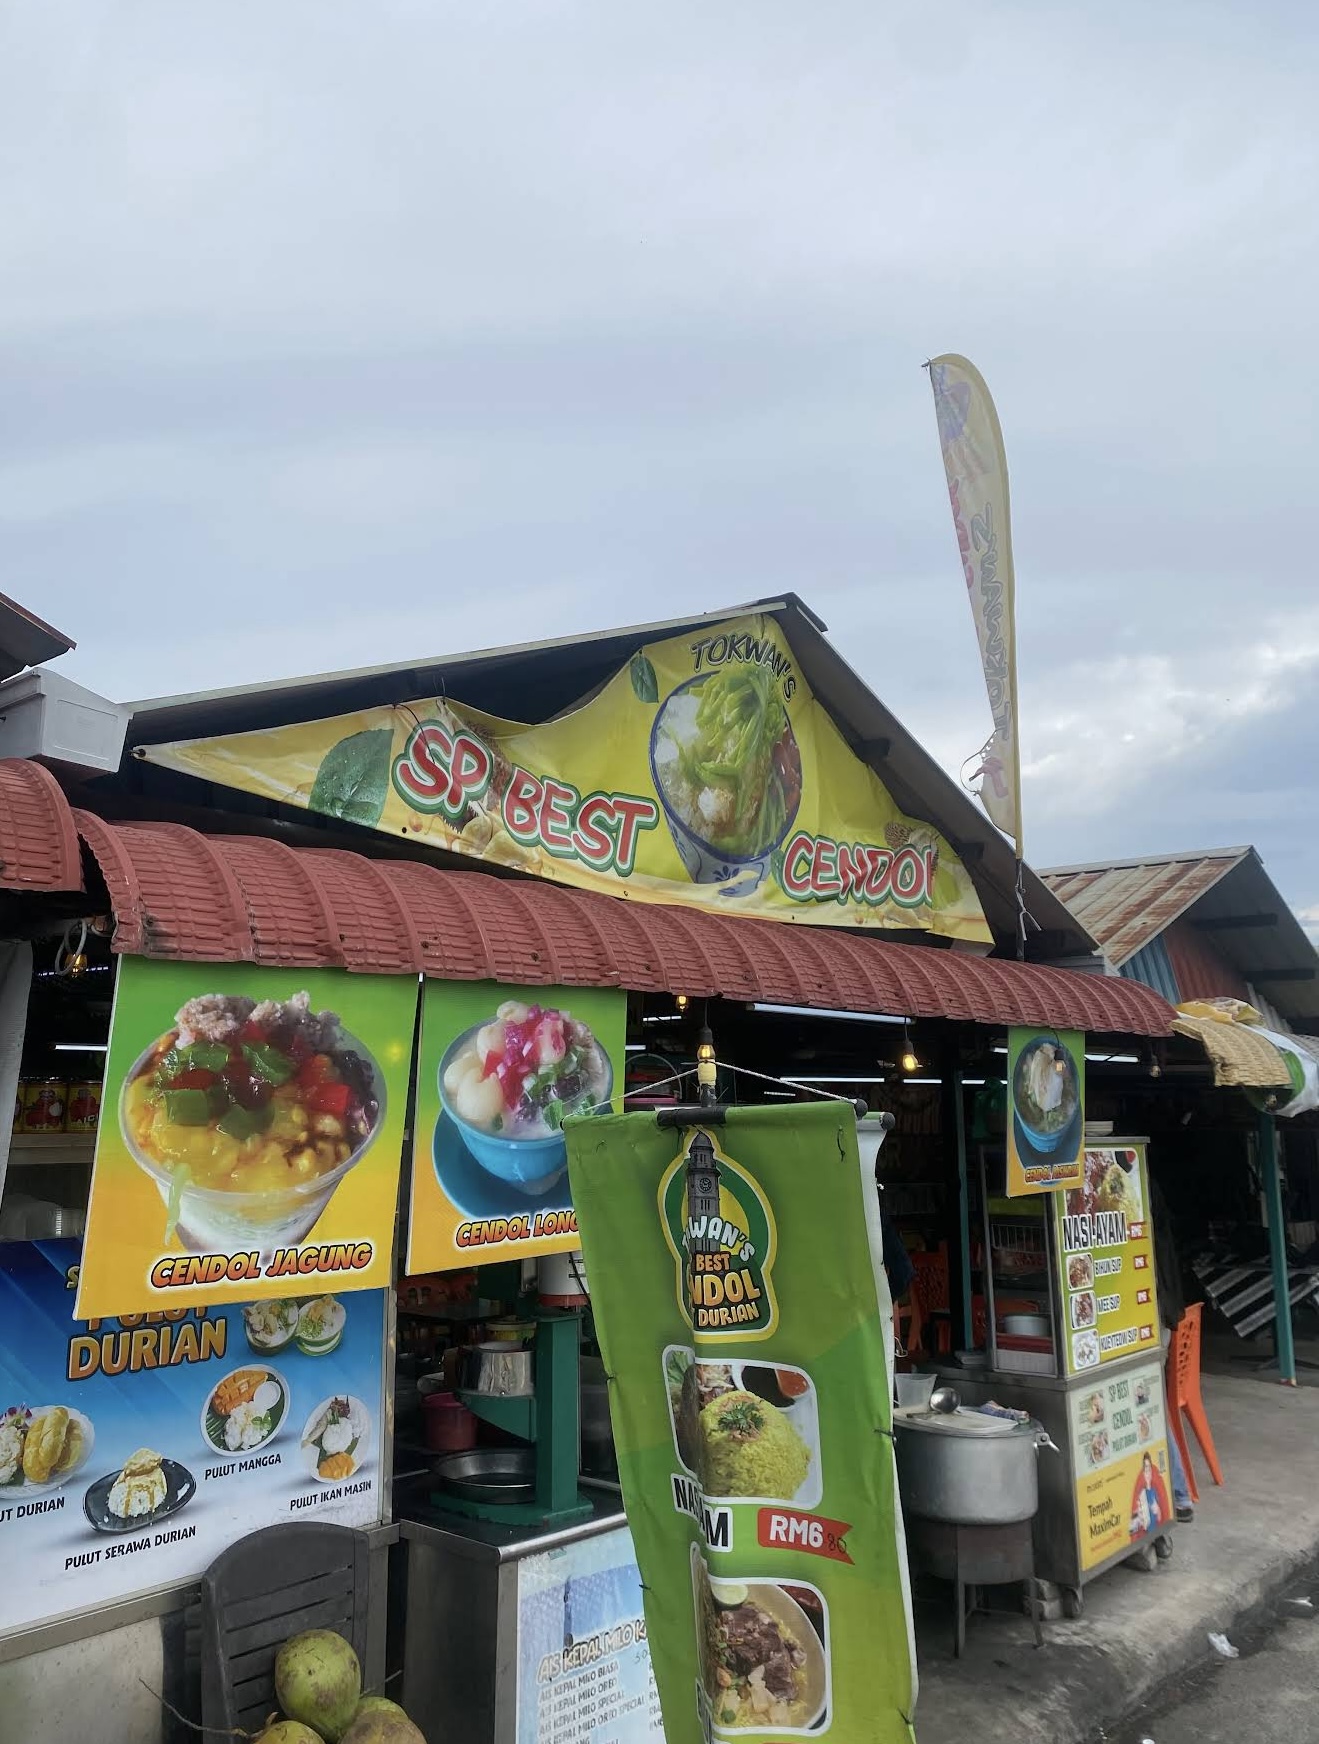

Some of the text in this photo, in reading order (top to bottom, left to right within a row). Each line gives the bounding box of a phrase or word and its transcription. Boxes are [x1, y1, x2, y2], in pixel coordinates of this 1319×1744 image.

[691, 634, 796, 702] TOKWAN'S
[395, 721, 657, 874] SP BEST
[456, 1216, 531, 1248] CENDOL
[1062, 1215, 1093, 1251] NASI
[1096, 1212, 1127, 1246] AYAM
[151, 1242, 373, 1289] CENDOL JAGUNG
[695, 1253, 730, 1272] BEST
[698, 1301, 760, 1328] DURIAN
[66, 1317, 227, 1381] DURIAN
[205, 1453, 282, 1481] PULUT MANGGA
[17, 1496, 65, 1519] DURIAN
[289, 1480, 372, 1511] PULUT IKAN MASIN
[1087, 1497, 1113, 1518] Tempah
[64, 1525, 197, 1571] PULUT SERAWA DURIAN
[769, 1514, 824, 1549] RM6
[538, 1653, 561, 1683] AIS
[562, 1635, 603, 1673] KEPAL
[603, 1624, 634, 1655] MILO
